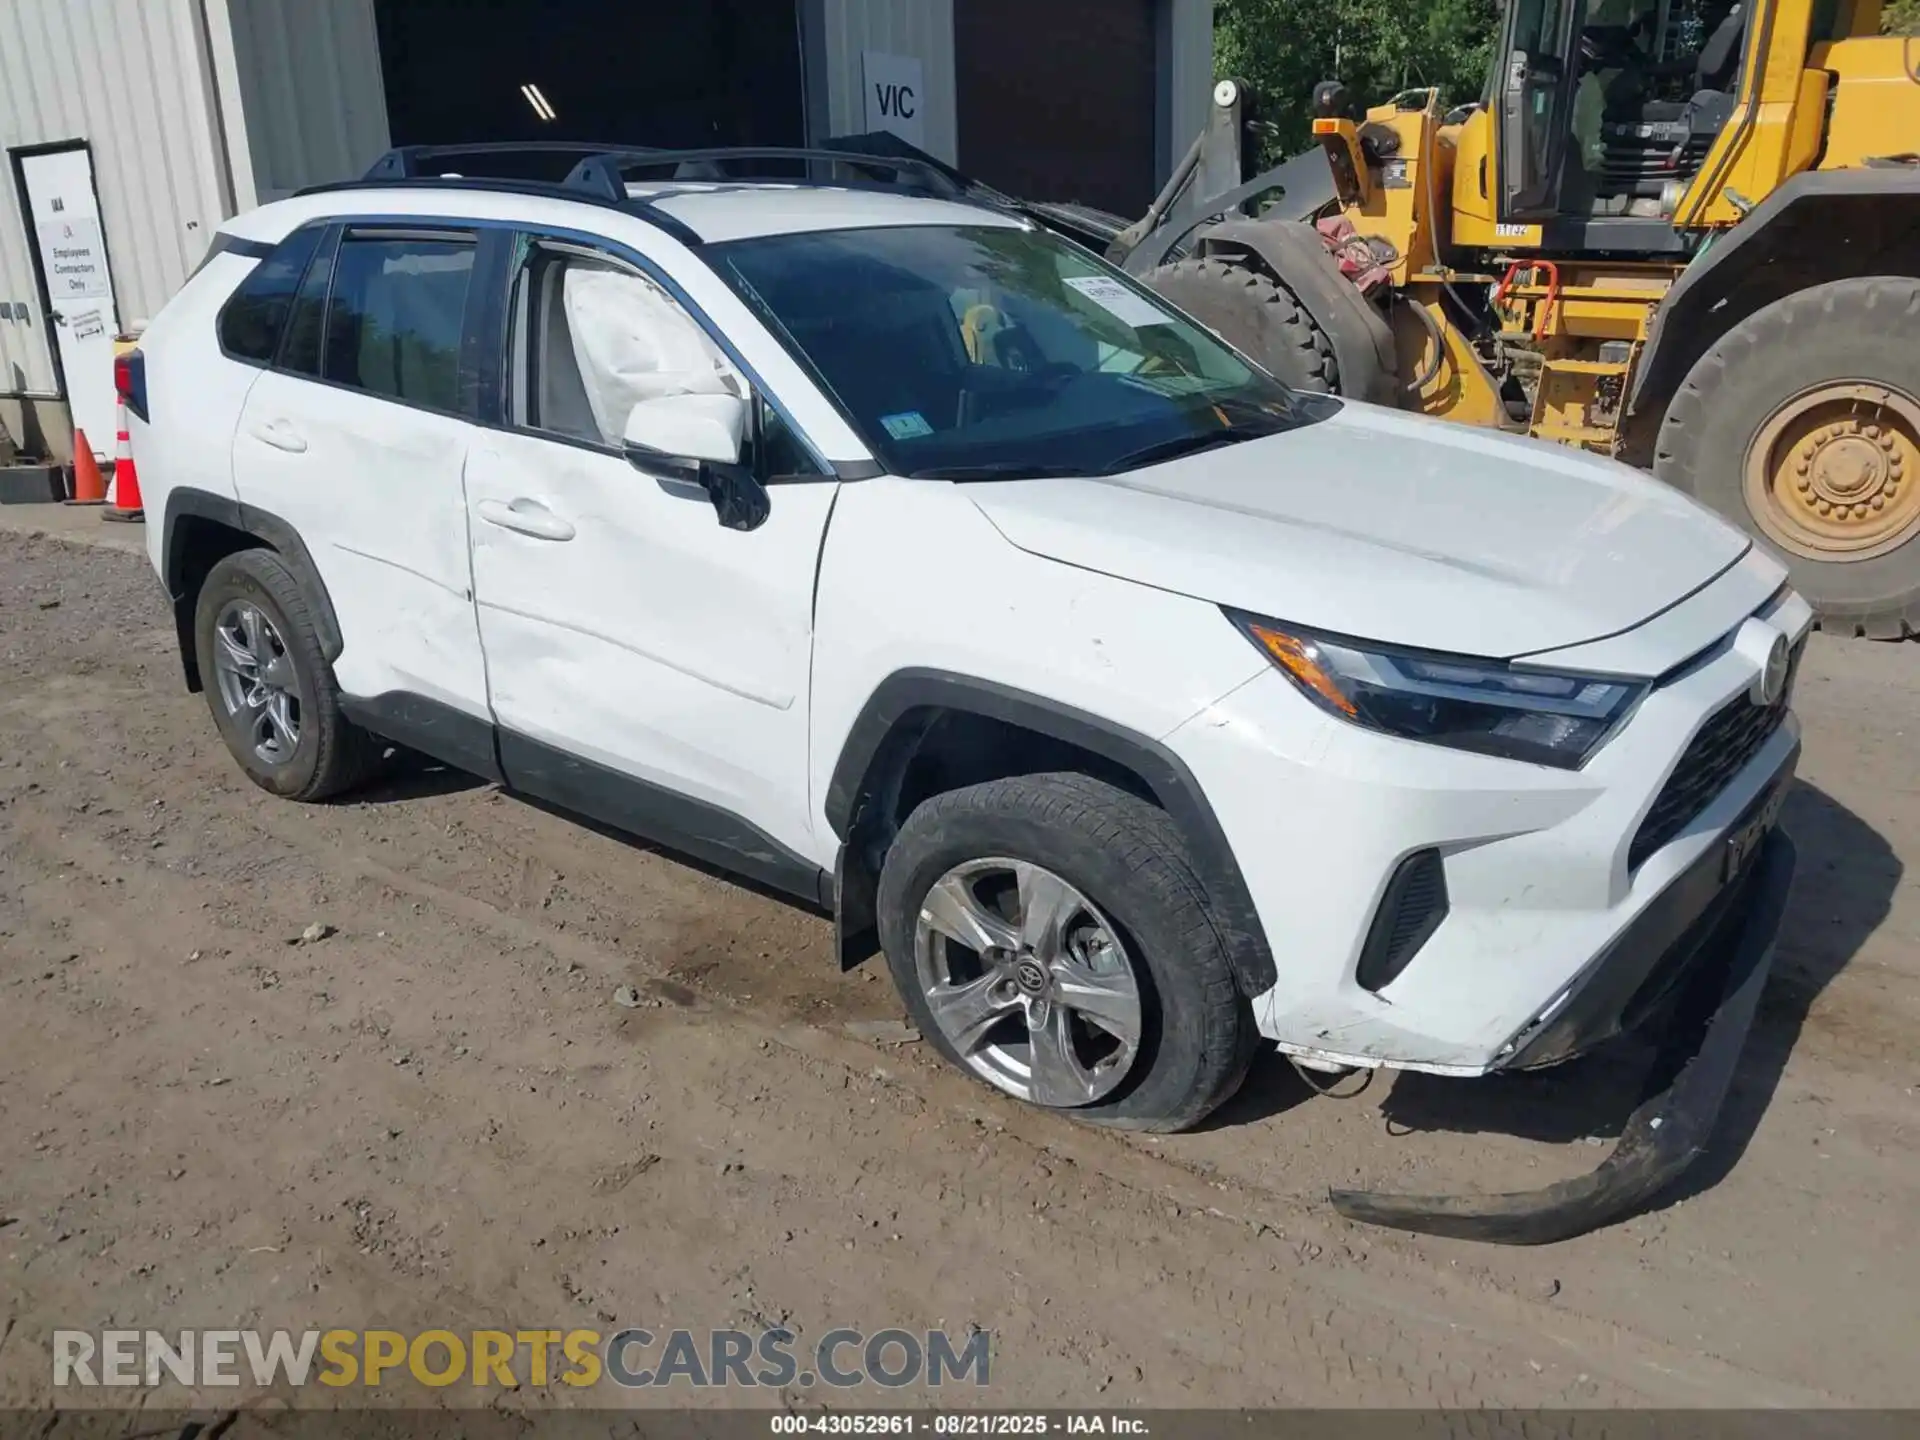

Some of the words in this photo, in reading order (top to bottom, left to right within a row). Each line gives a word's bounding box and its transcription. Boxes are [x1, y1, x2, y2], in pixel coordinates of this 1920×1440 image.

[876, 83, 915, 119] VIC
[52, 247, 91, 259] Employees
[54, 263, 95, 274] Contractors
[69, 279, 86, 291] Only
